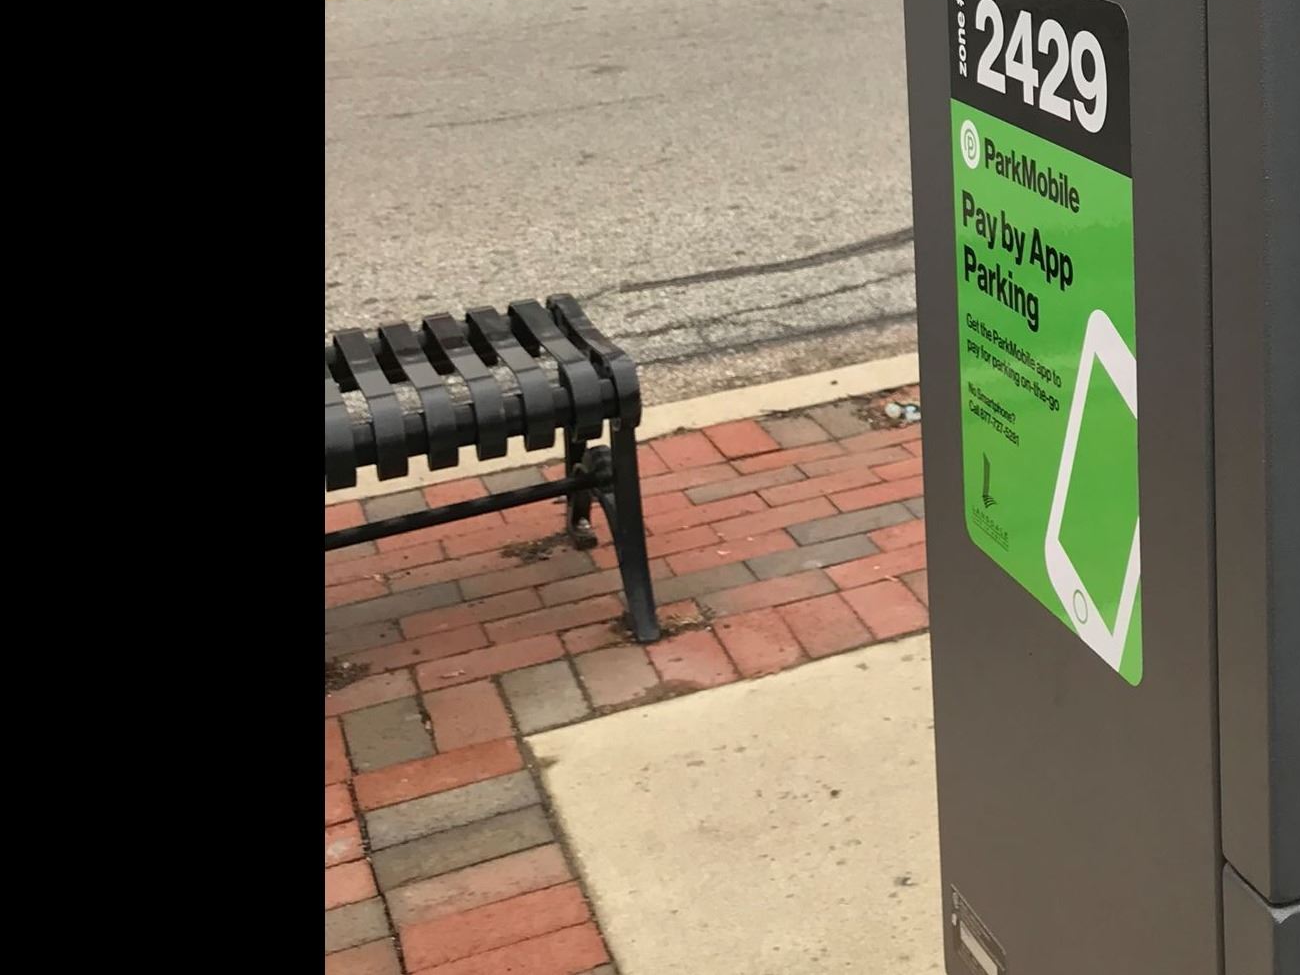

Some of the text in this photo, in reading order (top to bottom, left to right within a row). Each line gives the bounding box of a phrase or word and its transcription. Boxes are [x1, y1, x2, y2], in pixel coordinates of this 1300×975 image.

[957, 10, 967, 78] zone
[984, 137, 1080, 213] ParkMobile
[962, 189, 1073, 292] Pay by App
[964, 244, 1039, 332] Parking
[966, 312, 979, 334] Get
